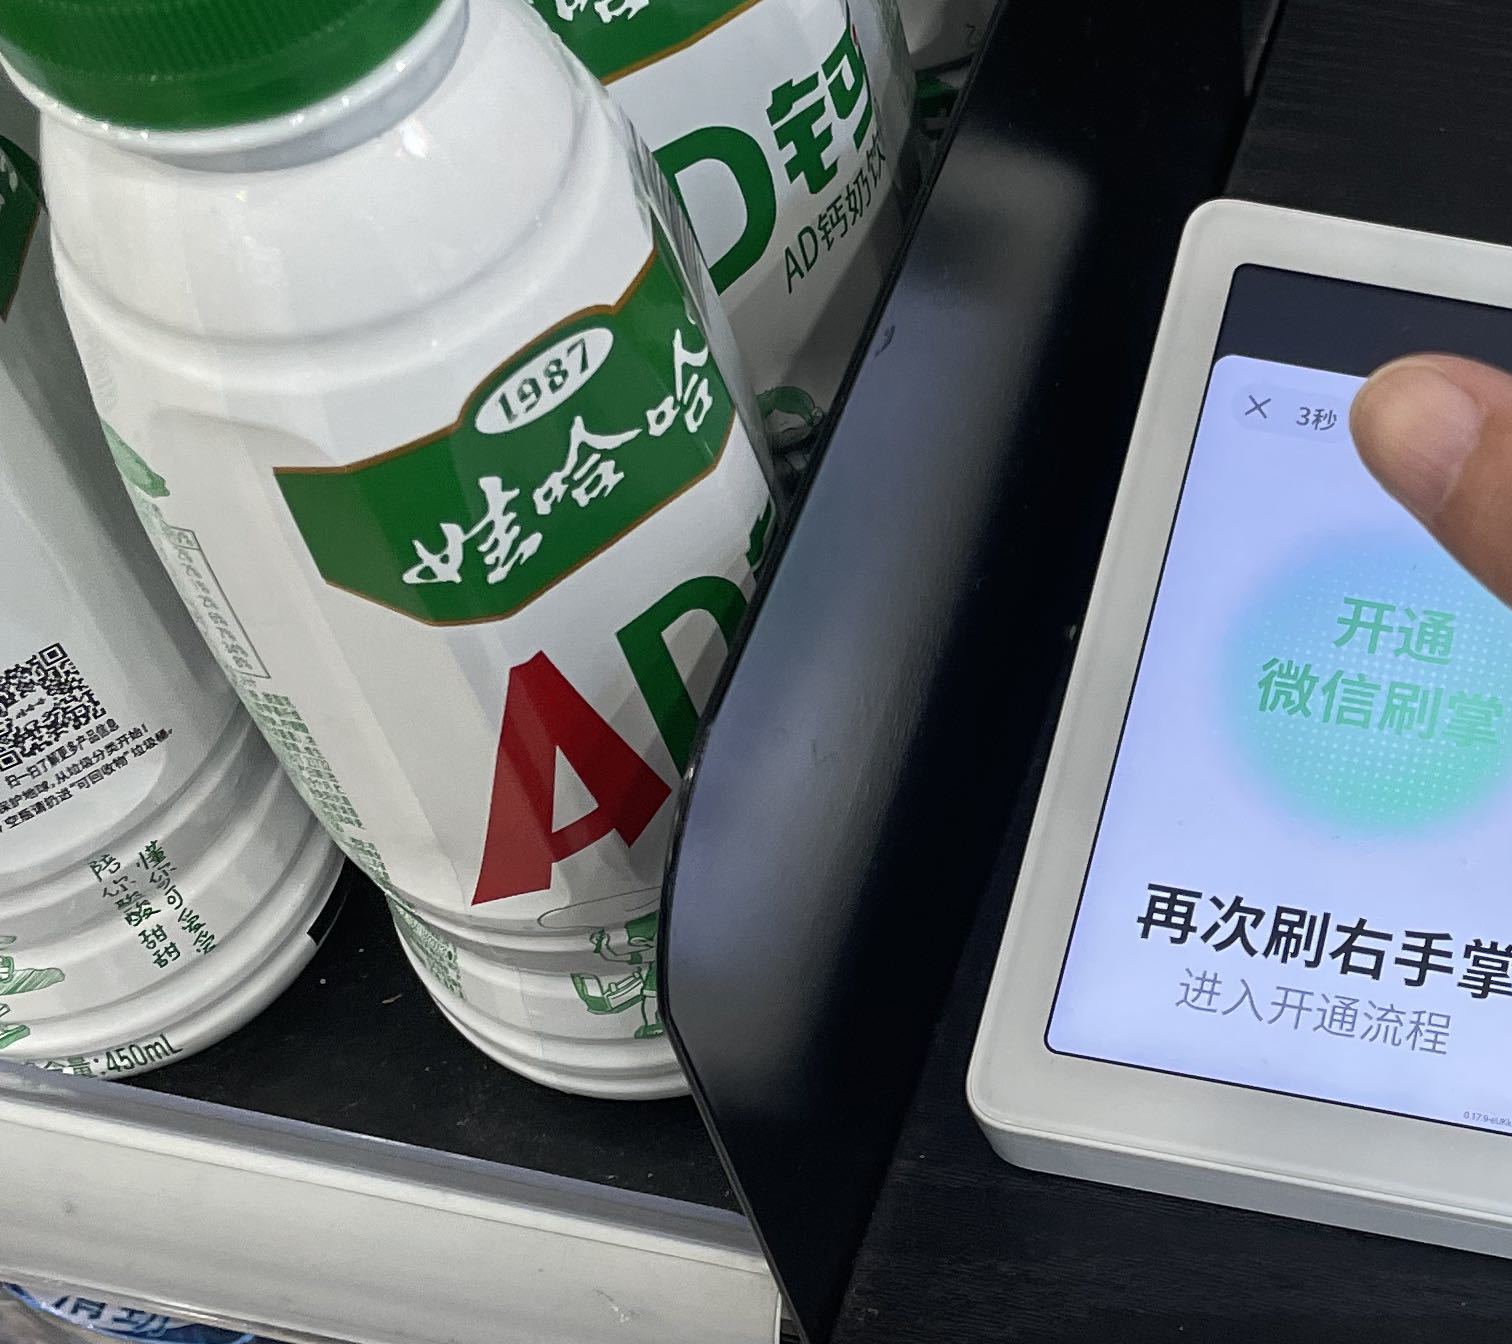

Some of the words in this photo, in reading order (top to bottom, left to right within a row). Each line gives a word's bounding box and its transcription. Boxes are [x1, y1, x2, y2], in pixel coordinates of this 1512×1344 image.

[497, 337, 589, 422] 1987
[1296, 405, 1338, 432] 3秒
[402, 329, 708, 584] 娃哈哈
[1333, 596, 1457, 666] 开通
[471, 502, 775, 906] AD
[1257, 656, 1503, 748] 微信刷掌
[1175, 967, 1453, 1055] 进入开通流程
